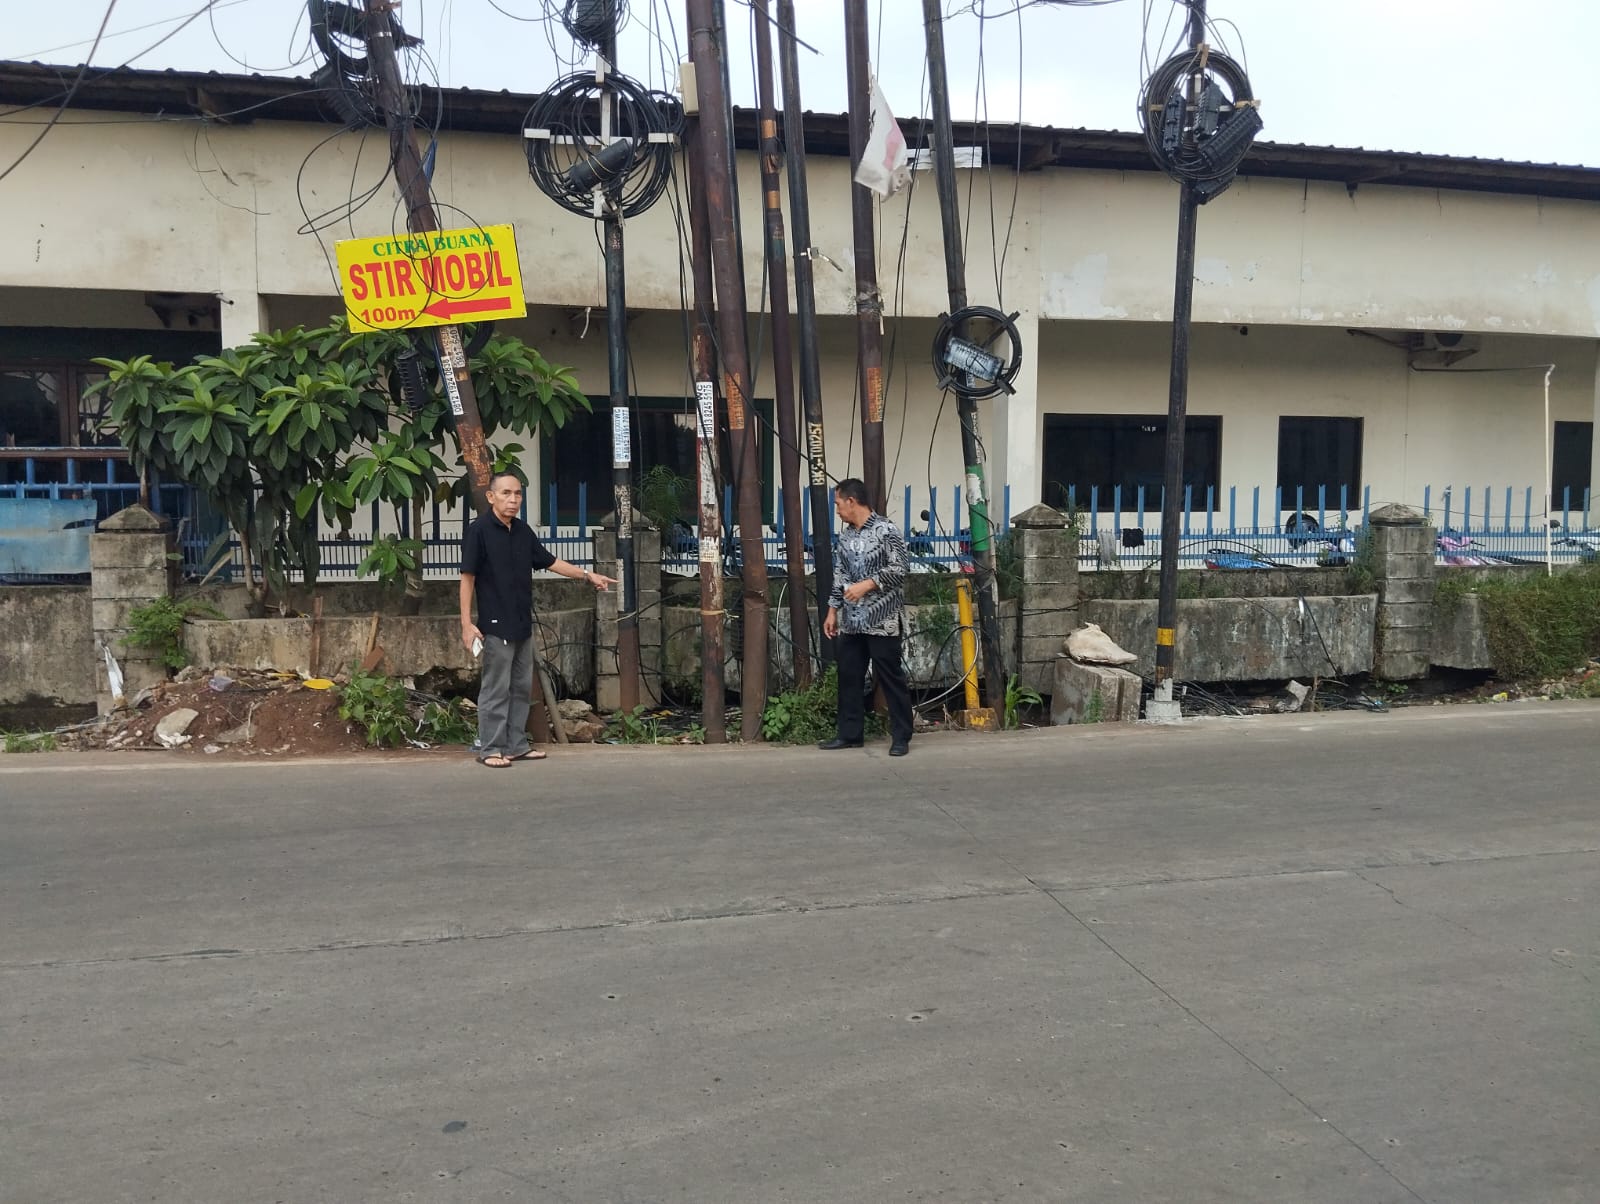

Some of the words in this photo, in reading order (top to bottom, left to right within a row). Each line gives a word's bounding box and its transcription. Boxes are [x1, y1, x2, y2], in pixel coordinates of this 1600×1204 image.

[373, 239, 429, 257] CITRA
[433, 232, 494, 250] BUANA
[349, 259, 416, 301] STIR
[421, 250, 513, 294] MOBIL
[360, 307, 416, 324] 100m
[447, 377, 457, 394] 1924
[703, 384, 712, 400] 5175
[451, 396, 462, 413] 0812
[703, 401, 713, 418] 8245
[807, 422, 825, 486] BKS-T00257
